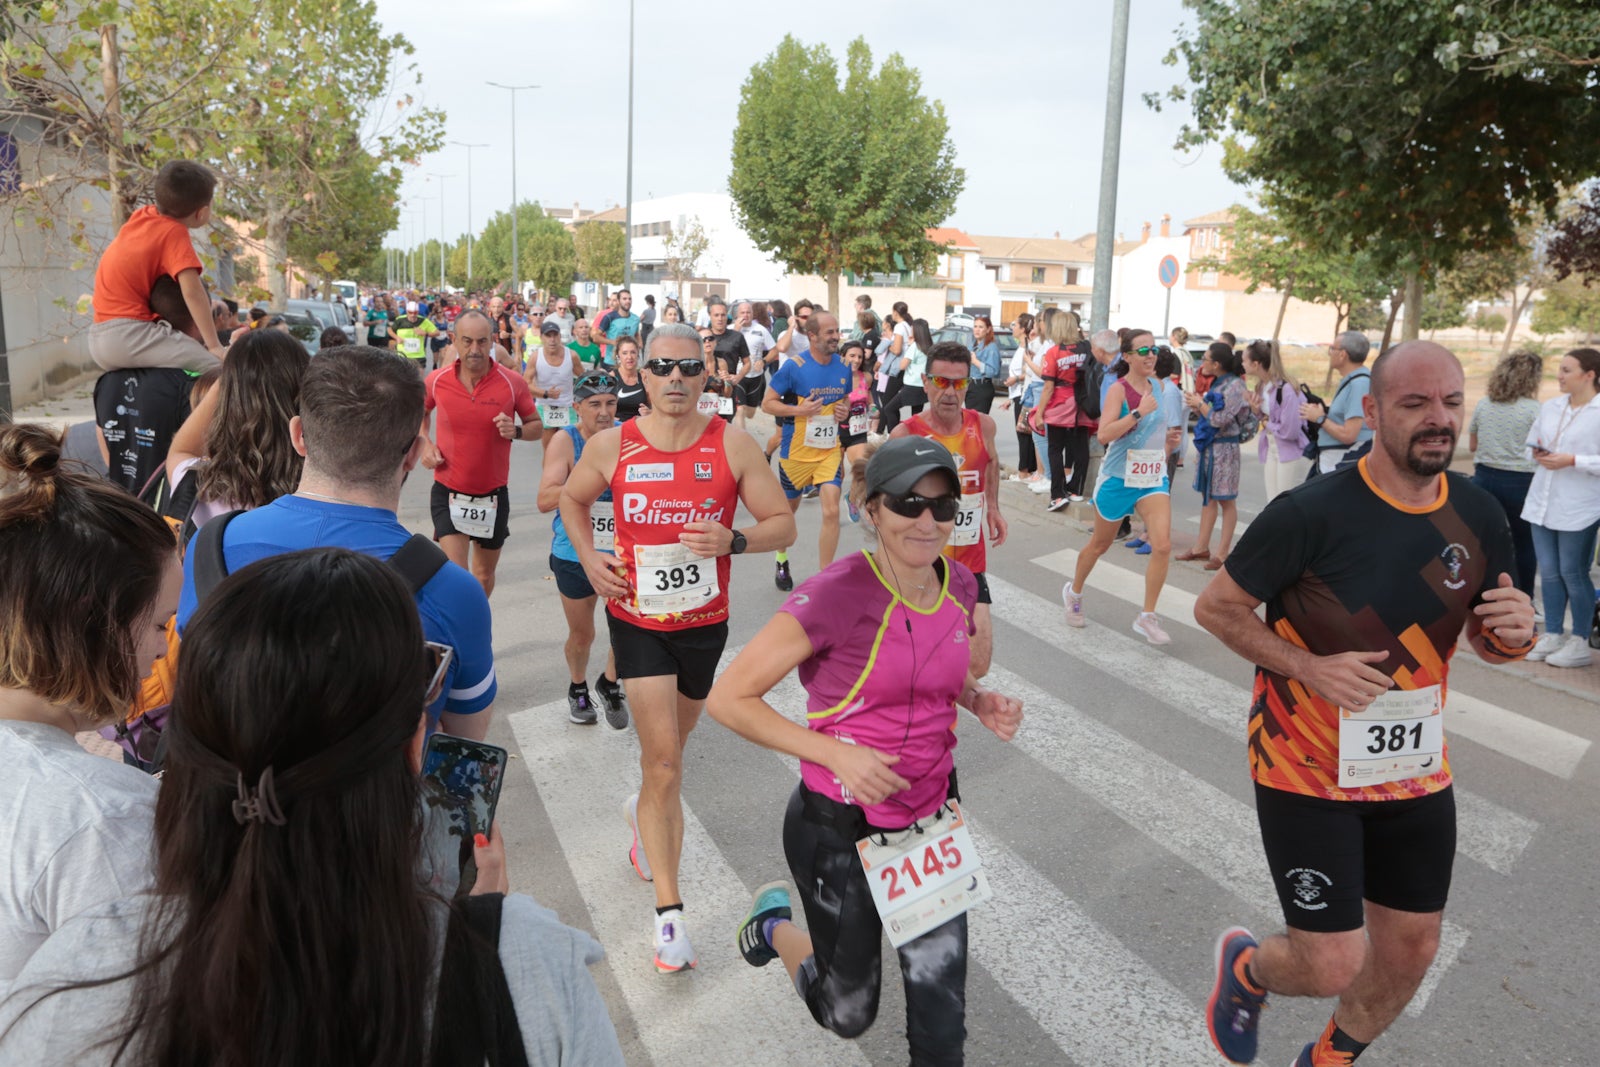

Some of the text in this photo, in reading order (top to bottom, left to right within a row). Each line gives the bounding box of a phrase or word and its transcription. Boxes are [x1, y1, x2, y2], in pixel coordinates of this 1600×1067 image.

[814, 426, 834, 437] 213
[1132, 462, 1161, 474] 2018
[623, 493, 725, 525] Polisalud
[652, 499, 693, 508] Clínicas
[460, 507, 486, 522] 781
[655, 564, 700, 591] 393
[1366, 722, 1423, 754] 381
[880, 835, 962, 901] 2145
